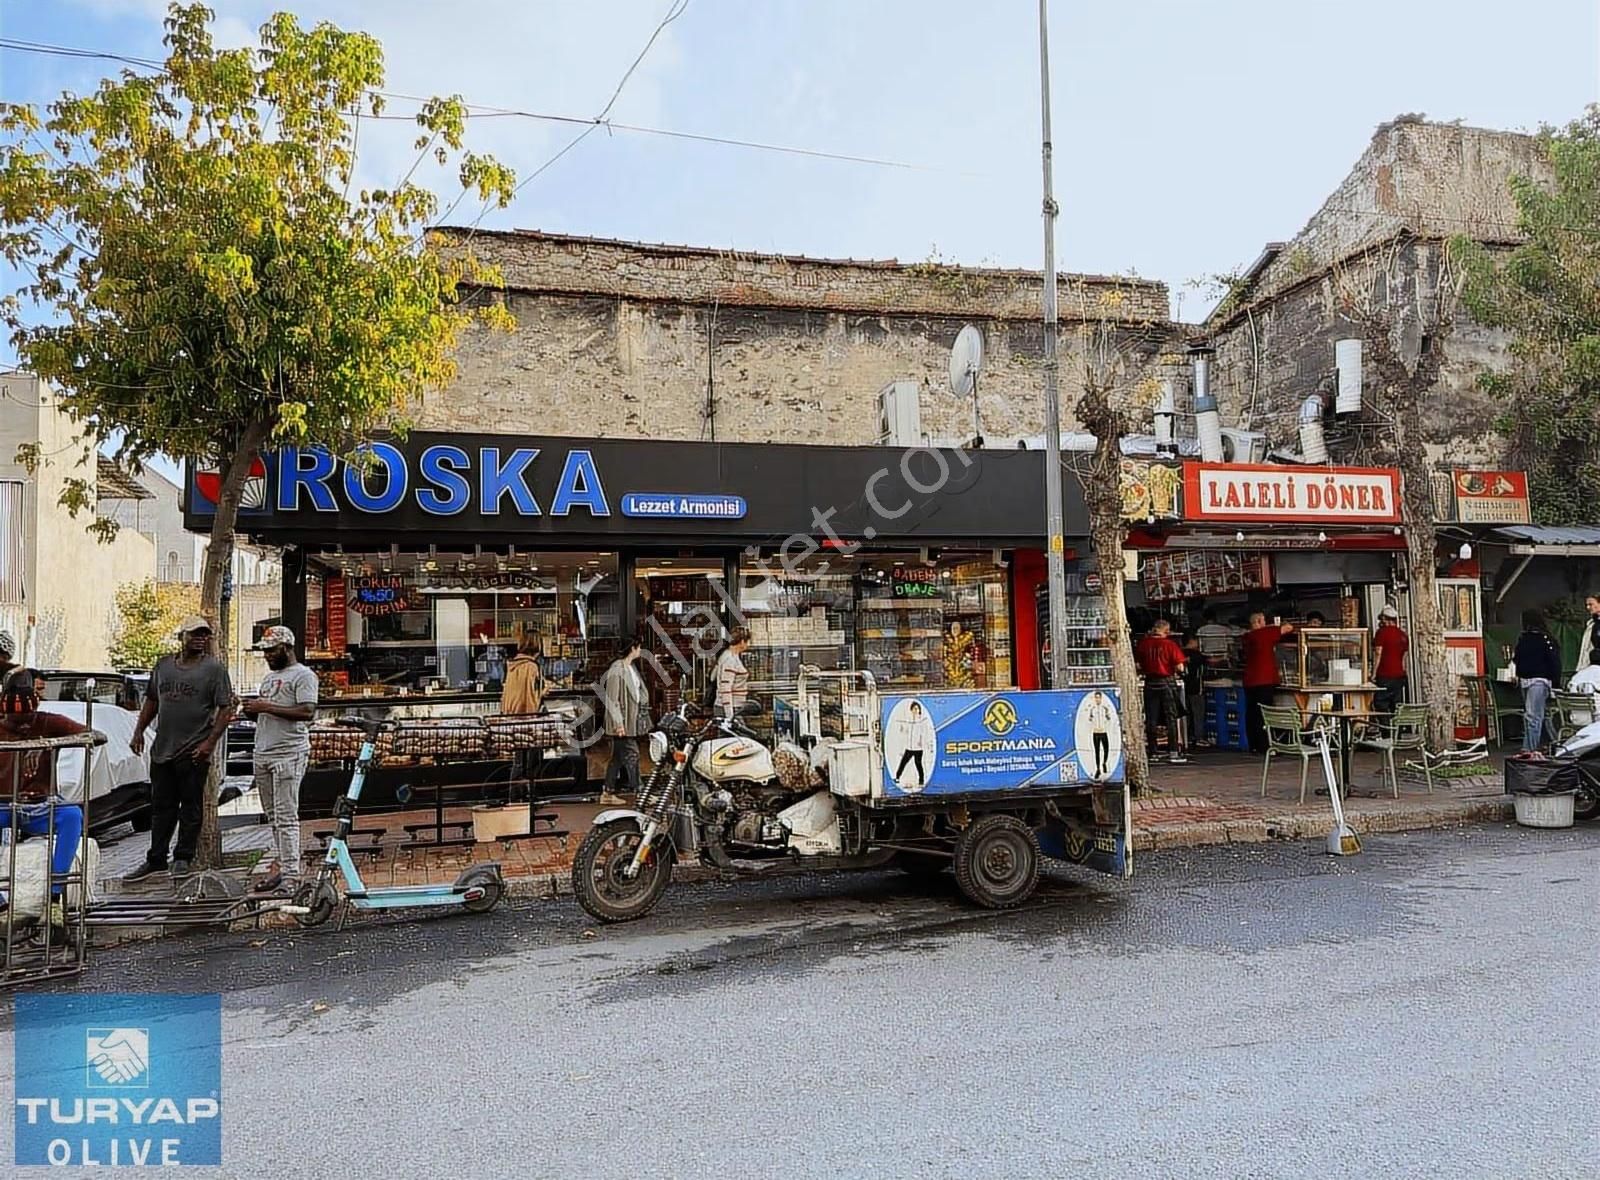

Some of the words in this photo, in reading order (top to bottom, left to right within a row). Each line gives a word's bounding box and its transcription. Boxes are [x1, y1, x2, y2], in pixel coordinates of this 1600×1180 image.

[277, 442, 611, 517] ROSKA
[1208, 476, 1297, 509] LALELİ
[1306, 476, 1387, 511] DÖNER
[629, 497, 675, 513] Lezzet
[679, 498, 740, 515] Armonisi
[352, 576, 404, 589] LOKUM
[895, 582, 937, 596] DRAJE
[945, 737, 1056, 754] SPORTMANIA
